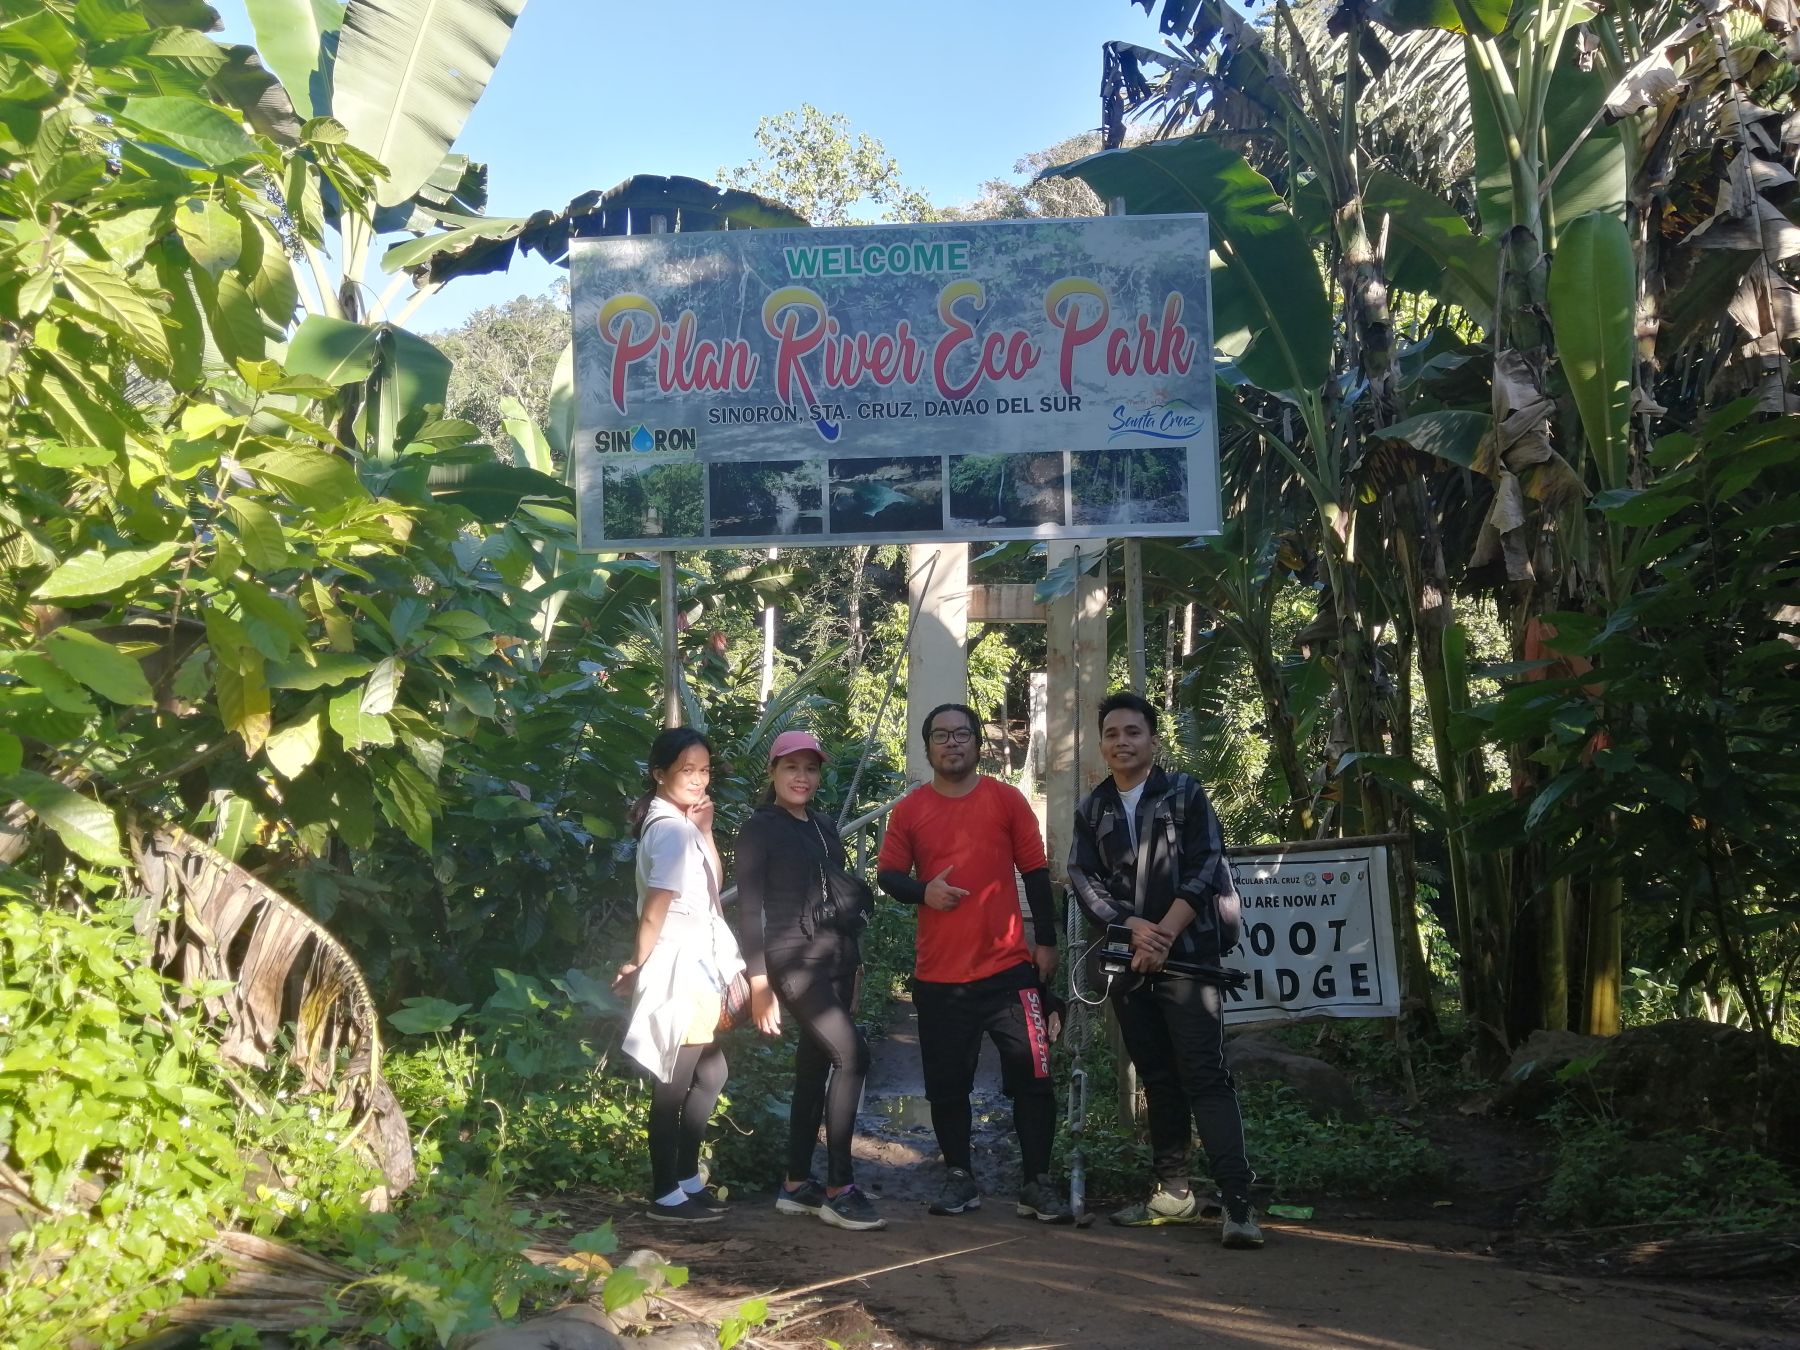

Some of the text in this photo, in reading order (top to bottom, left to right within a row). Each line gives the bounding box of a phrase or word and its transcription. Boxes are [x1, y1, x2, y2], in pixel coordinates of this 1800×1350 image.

[785, 242, 969, 277] WELCOME
[597, 276, 1197, 444] Pilan River Eco Park
[708, 396, 1082, 424] SINORON, STA. CRUZ, DAVAO DEL SUR
[1108, 405, 1196, 432] Santa Cruz
[1281, 876, 1300, 884] CRUZ
[1255, 895, 1279, 908] ARE
[1283, 894, 1317, 907] NOW
[1321, 893, 1337, 906] AT
[1249, 919, 1347, 957] OOT
